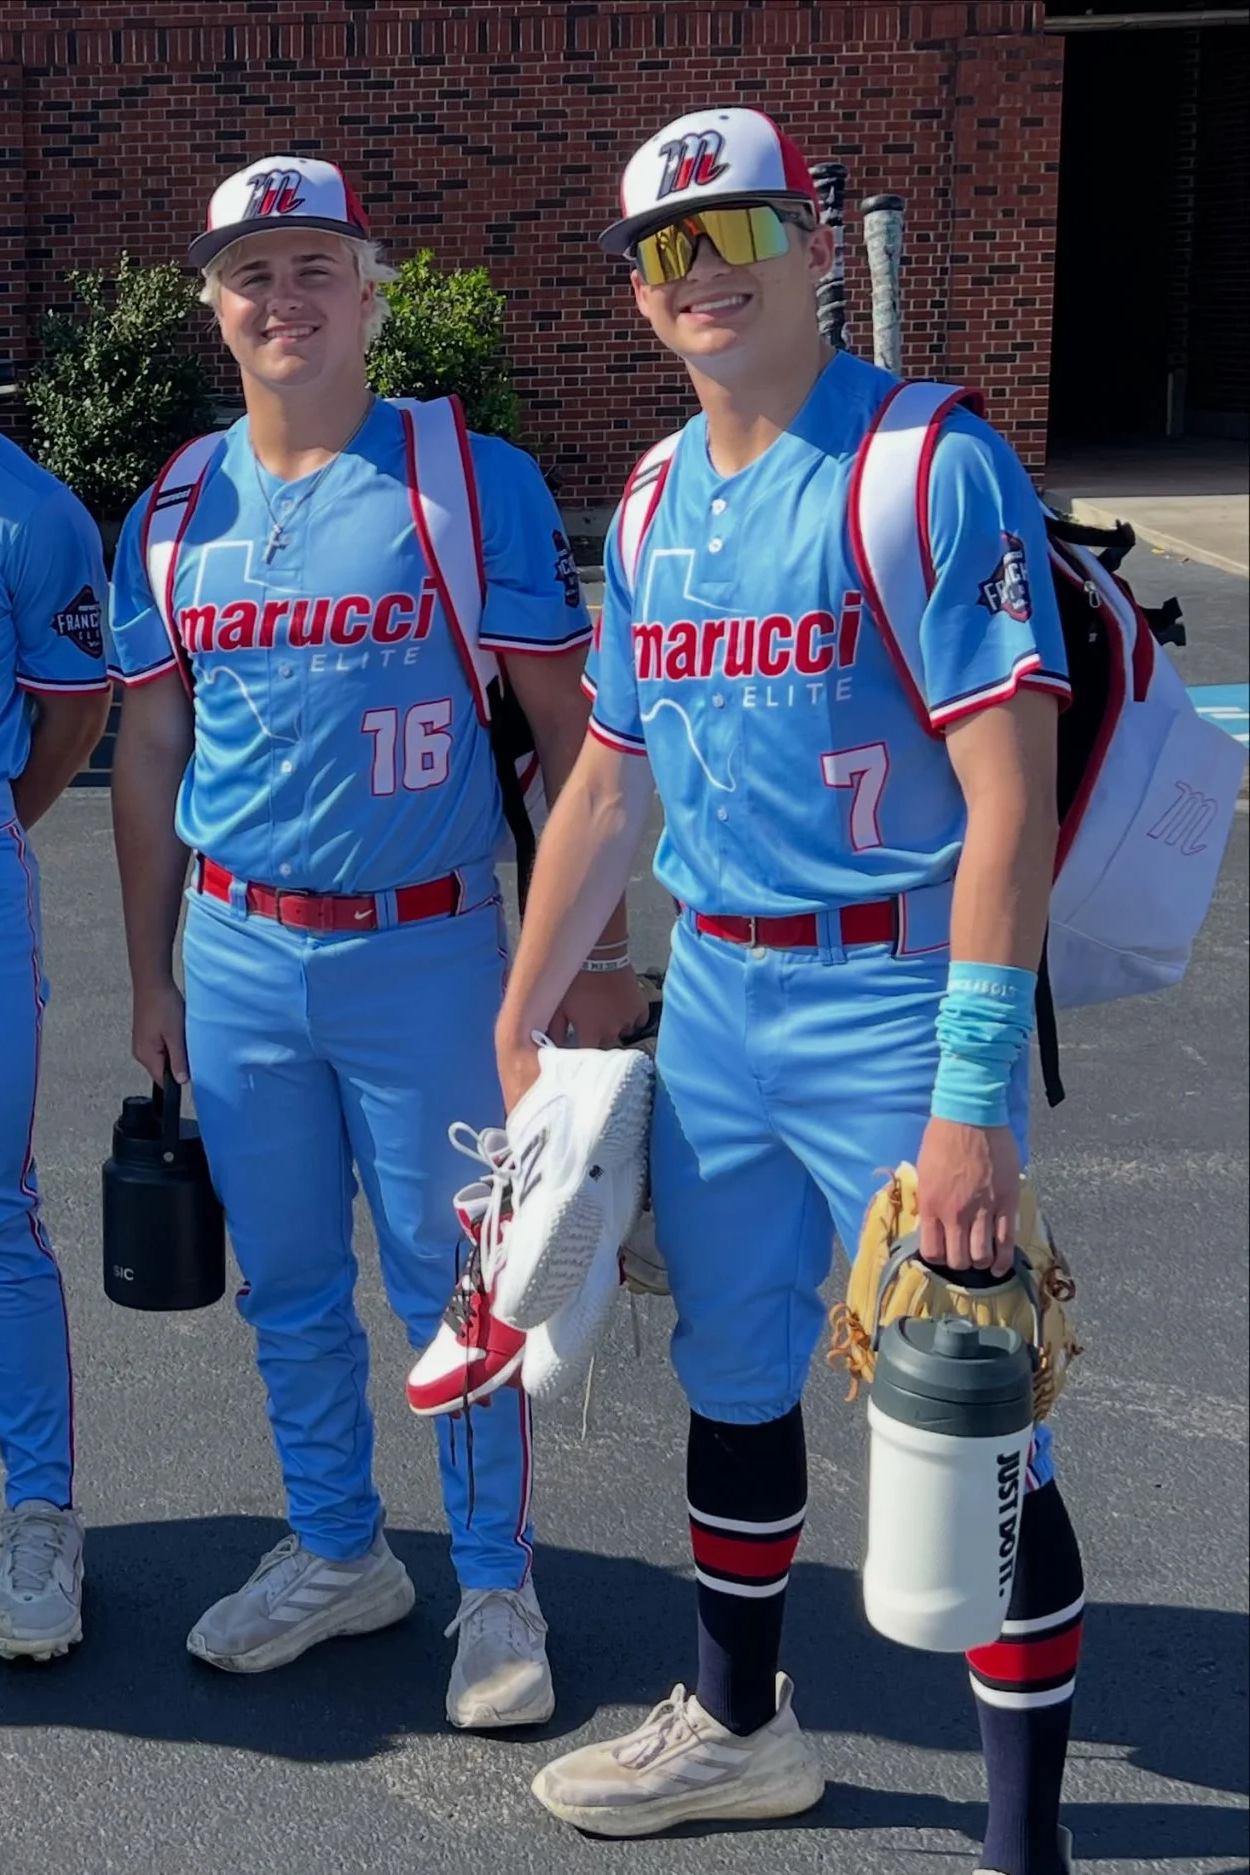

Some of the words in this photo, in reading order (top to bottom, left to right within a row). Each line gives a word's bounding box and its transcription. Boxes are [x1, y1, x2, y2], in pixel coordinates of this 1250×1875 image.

[179, 576, 440, 654] marucci
[631, 589, 863, 682] marucci
[310, 647, 420, 673] ELITE
[742, 677, 853, 708] ELITE
[361, 698, 454, 797] 16
[820, 741, 889, 852] 7
[112, 1264, 135, 1281] SIC
[996, 1449, 1022, 1515] JUST
[998, 1512, 1017, 1559] DO
